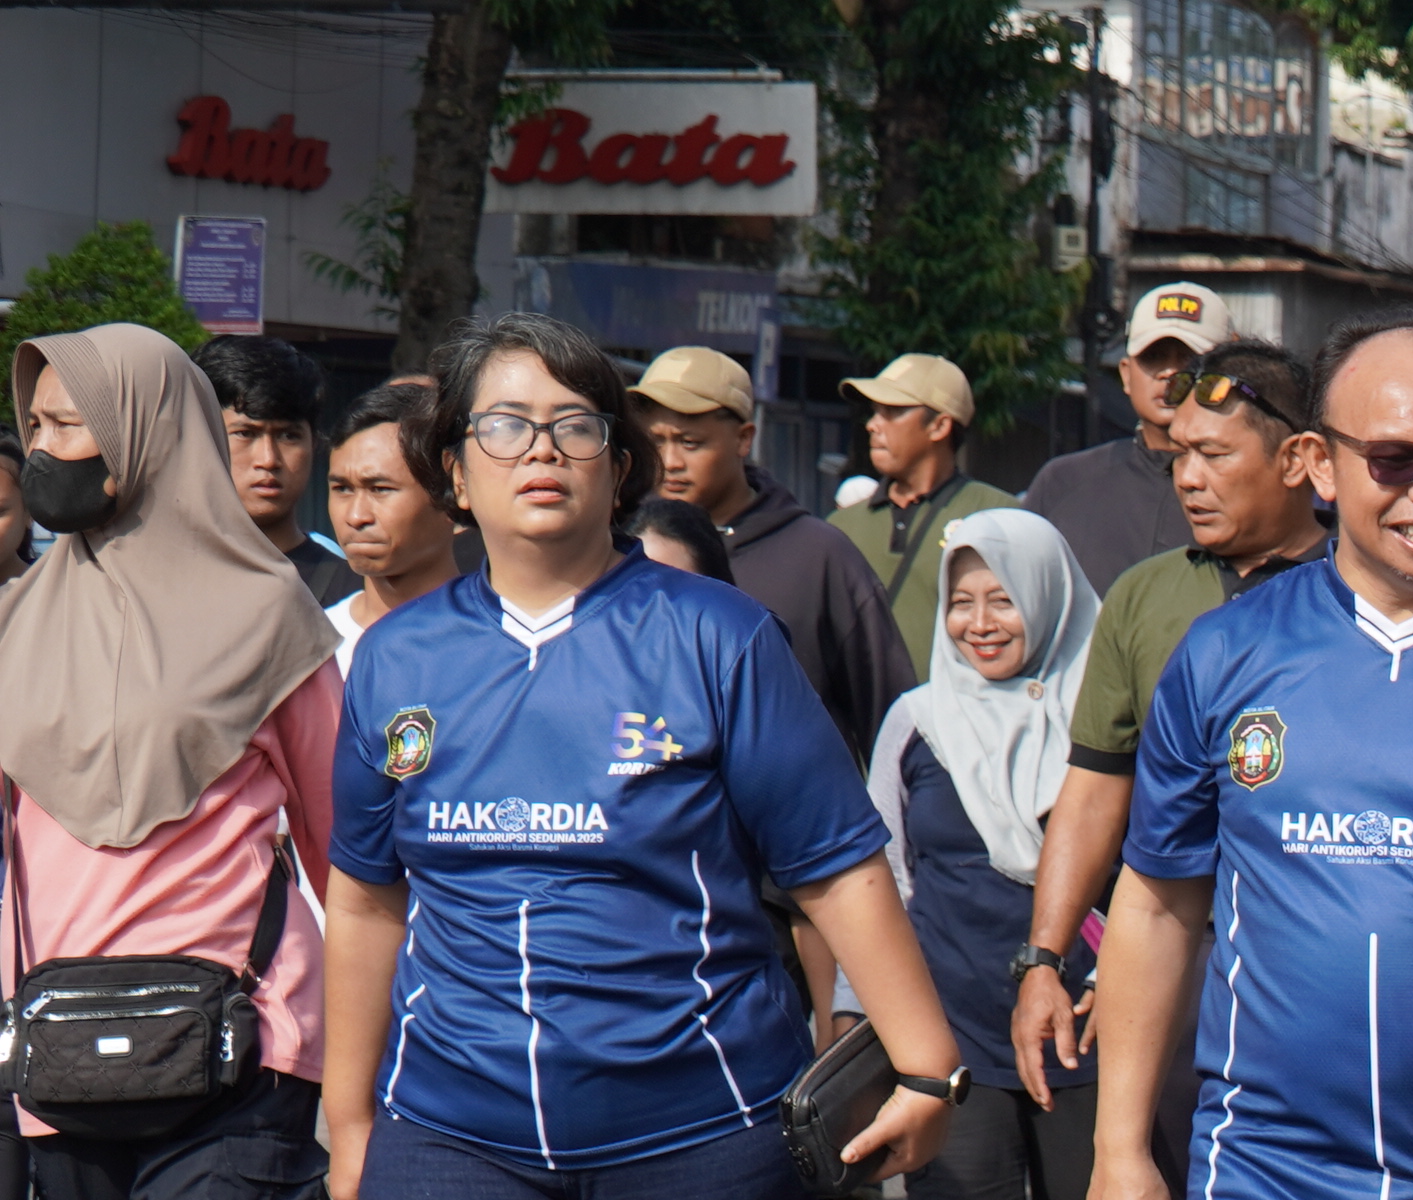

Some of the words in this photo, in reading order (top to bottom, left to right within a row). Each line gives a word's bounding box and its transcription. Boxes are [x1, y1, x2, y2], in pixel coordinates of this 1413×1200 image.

[166, 96, 332, 191] Bata
[491, 107, 796, 187] Bata
[1158, 297, 1180, 312] POL
[1181, 298, 1198, 314] PP
[427, 832, 452, 843] HARI
[454, 832, 527, 843] ANTIKORUPSI
[529, 832, 576, 843] SEDUNIA
[577, 833, 604, 843] 2025
[1283, 843, 1309, 853] HARI
[1311, 844, 1387, 856] ANTIKORUPSI
